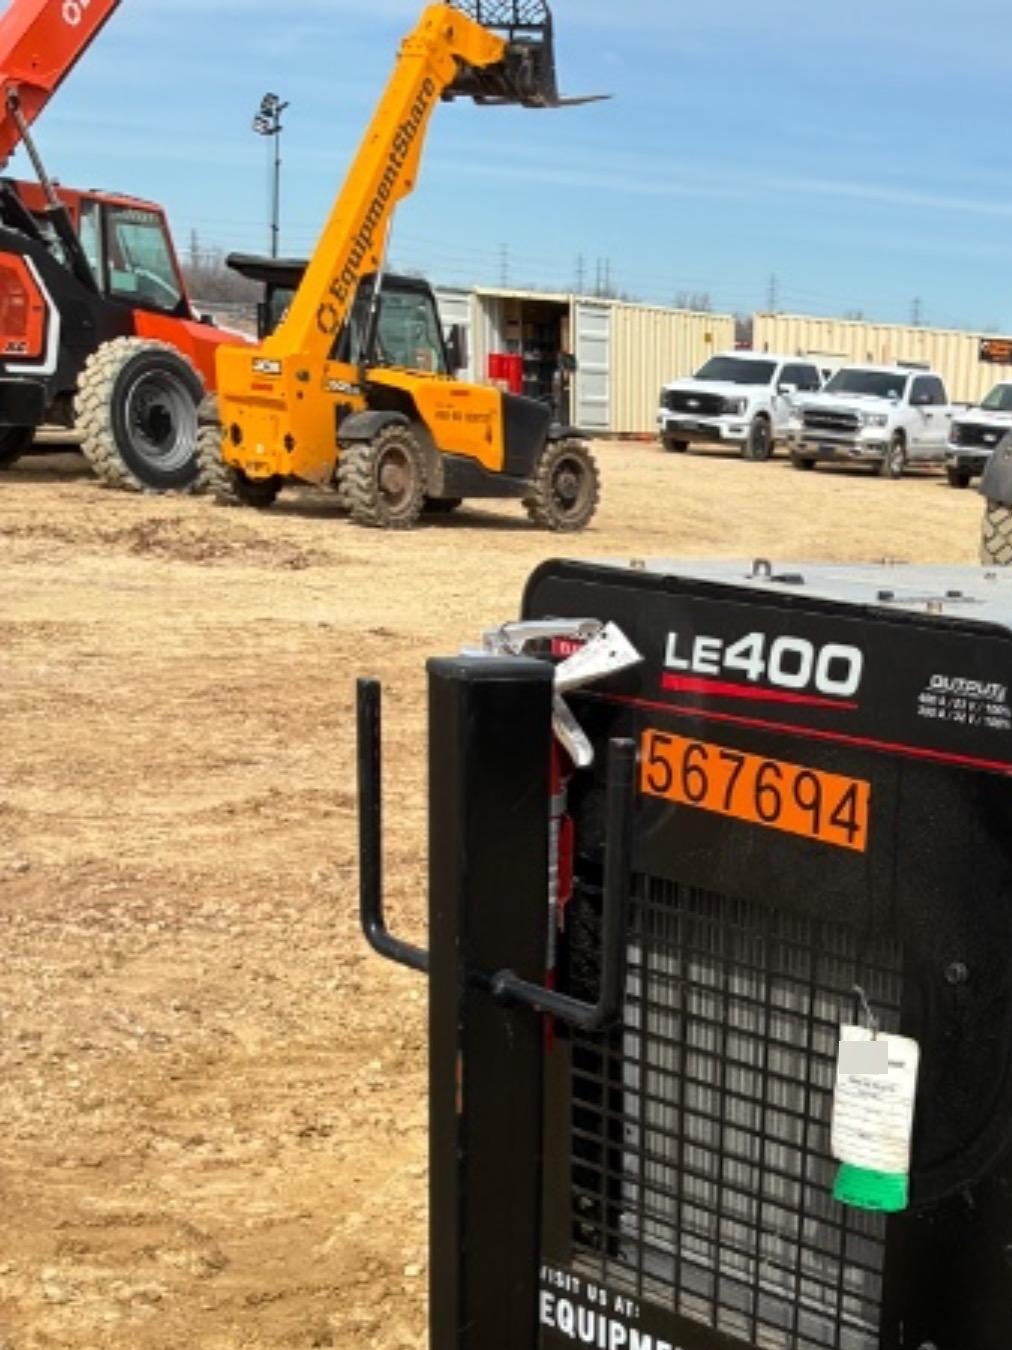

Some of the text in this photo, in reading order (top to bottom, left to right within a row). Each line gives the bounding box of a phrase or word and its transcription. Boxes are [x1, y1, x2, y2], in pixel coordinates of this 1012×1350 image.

[330, 78, 434, 302] EquipmentShare
[664, 632, 862, 696] LE400
[647, 734, 861, 845] 567694
[586, 1283, 607, 1306] US
[614, 1295, 640, 1318] AT:
